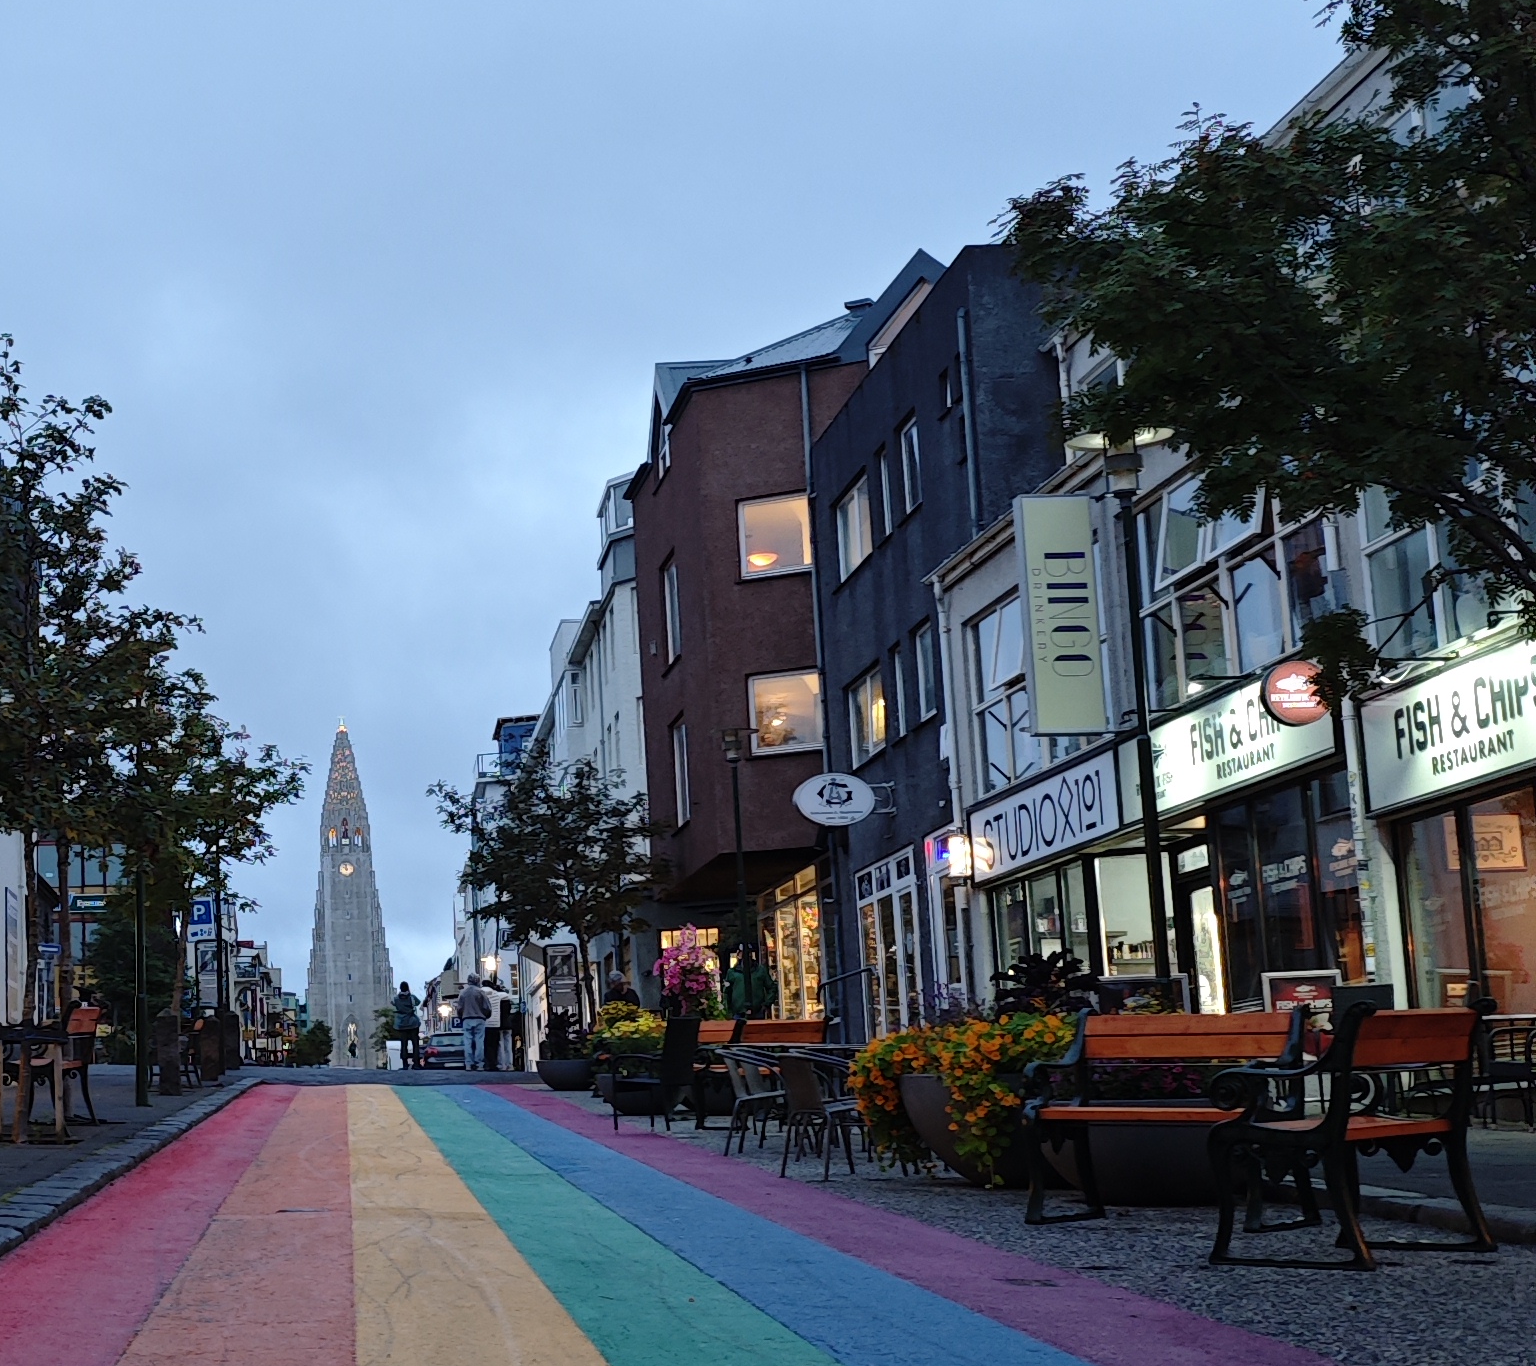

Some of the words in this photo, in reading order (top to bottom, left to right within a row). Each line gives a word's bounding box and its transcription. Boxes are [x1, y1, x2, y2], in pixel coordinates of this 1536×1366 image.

[1031, 568, 1048, 663] DRINKERY
[1044, 551, 1095, 677] BINGO
[1190, 711, 1226, 765] FISH
[1229, 708, 1244, 750] &
[1394, 694, 1444, 760] FISH
[1451, 690, 1471, 739] &
[1216, 742, 1276, 780] RESTAURANT
[1431, 728, 1515, 776] RESTAURANT
[193, 904, 206, 921] P
[453, 1017, 461, 1027] P
